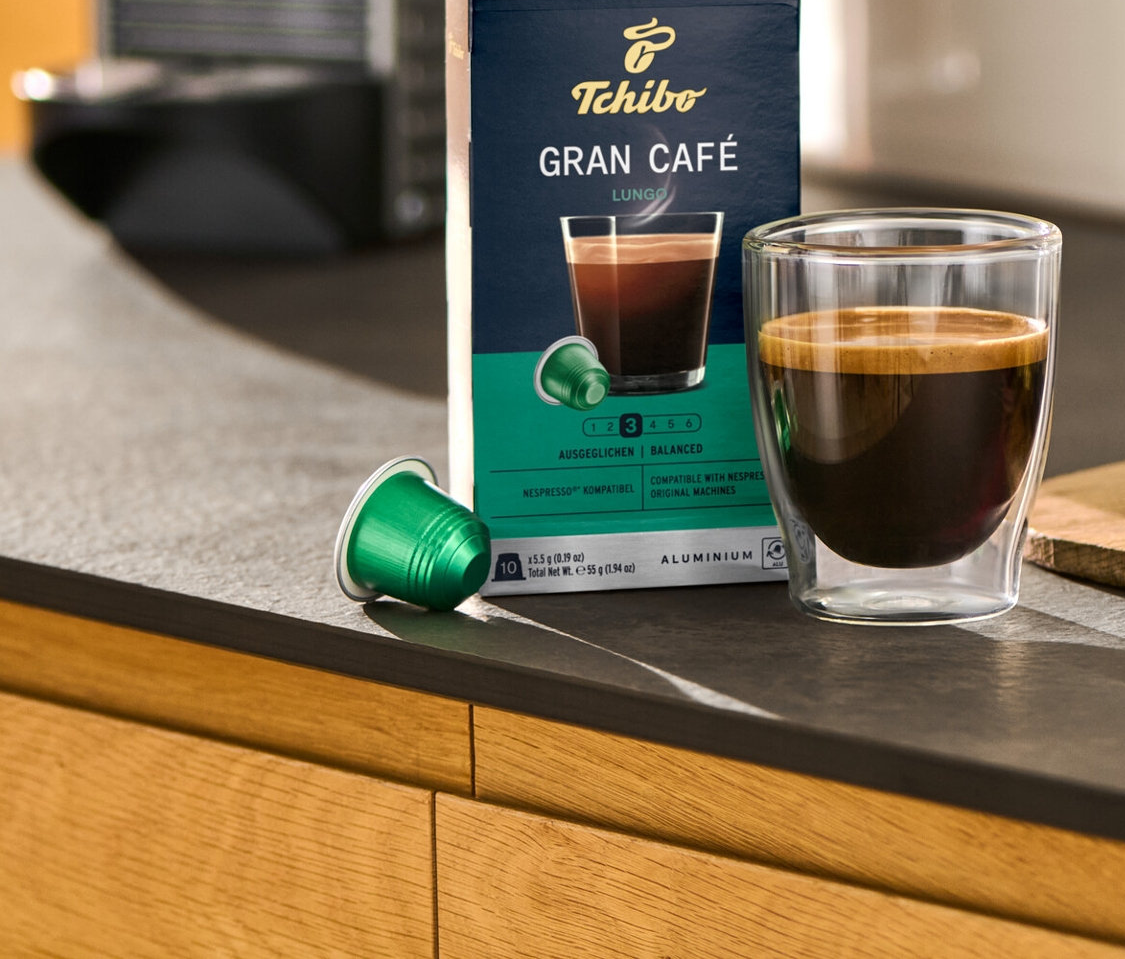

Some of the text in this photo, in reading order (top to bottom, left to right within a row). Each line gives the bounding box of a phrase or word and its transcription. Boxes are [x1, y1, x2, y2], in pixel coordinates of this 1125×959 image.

[571, 80, 707, 114] Tchibo
[539, 134, 738, 177] GRAN CAFÉ
[612, 188, 667, 202] LUNGO
[592, 418, 692, 434] 1 2 3 4 5 6
[559, 444, 702, 460] AUSGEGLICHEN BALANCED
[651, 471, 765, 484] COMPATIBLE WITH NESPRES
[584, 484, 634, 494] KOMPATIBEL
[651, 486, 735, 498] ORIGINAL MACHINES
[548, 556, 552, 566] g
[554, 553, 570, 564] (0.19
[573, 552, 584, 563] oz)
[661, 551, 752, 564] ALUMINIUM
[500, 561, 517, 574] 10
[528, 567, 546, 577] Total
[548, 566, 560, 576] Net
[562, 566, 573, 576] Wt.
[598, 566, 602, 576] g
[605, 564, 622, 574] (1.94
[624, 563, 635, 574] oz)
